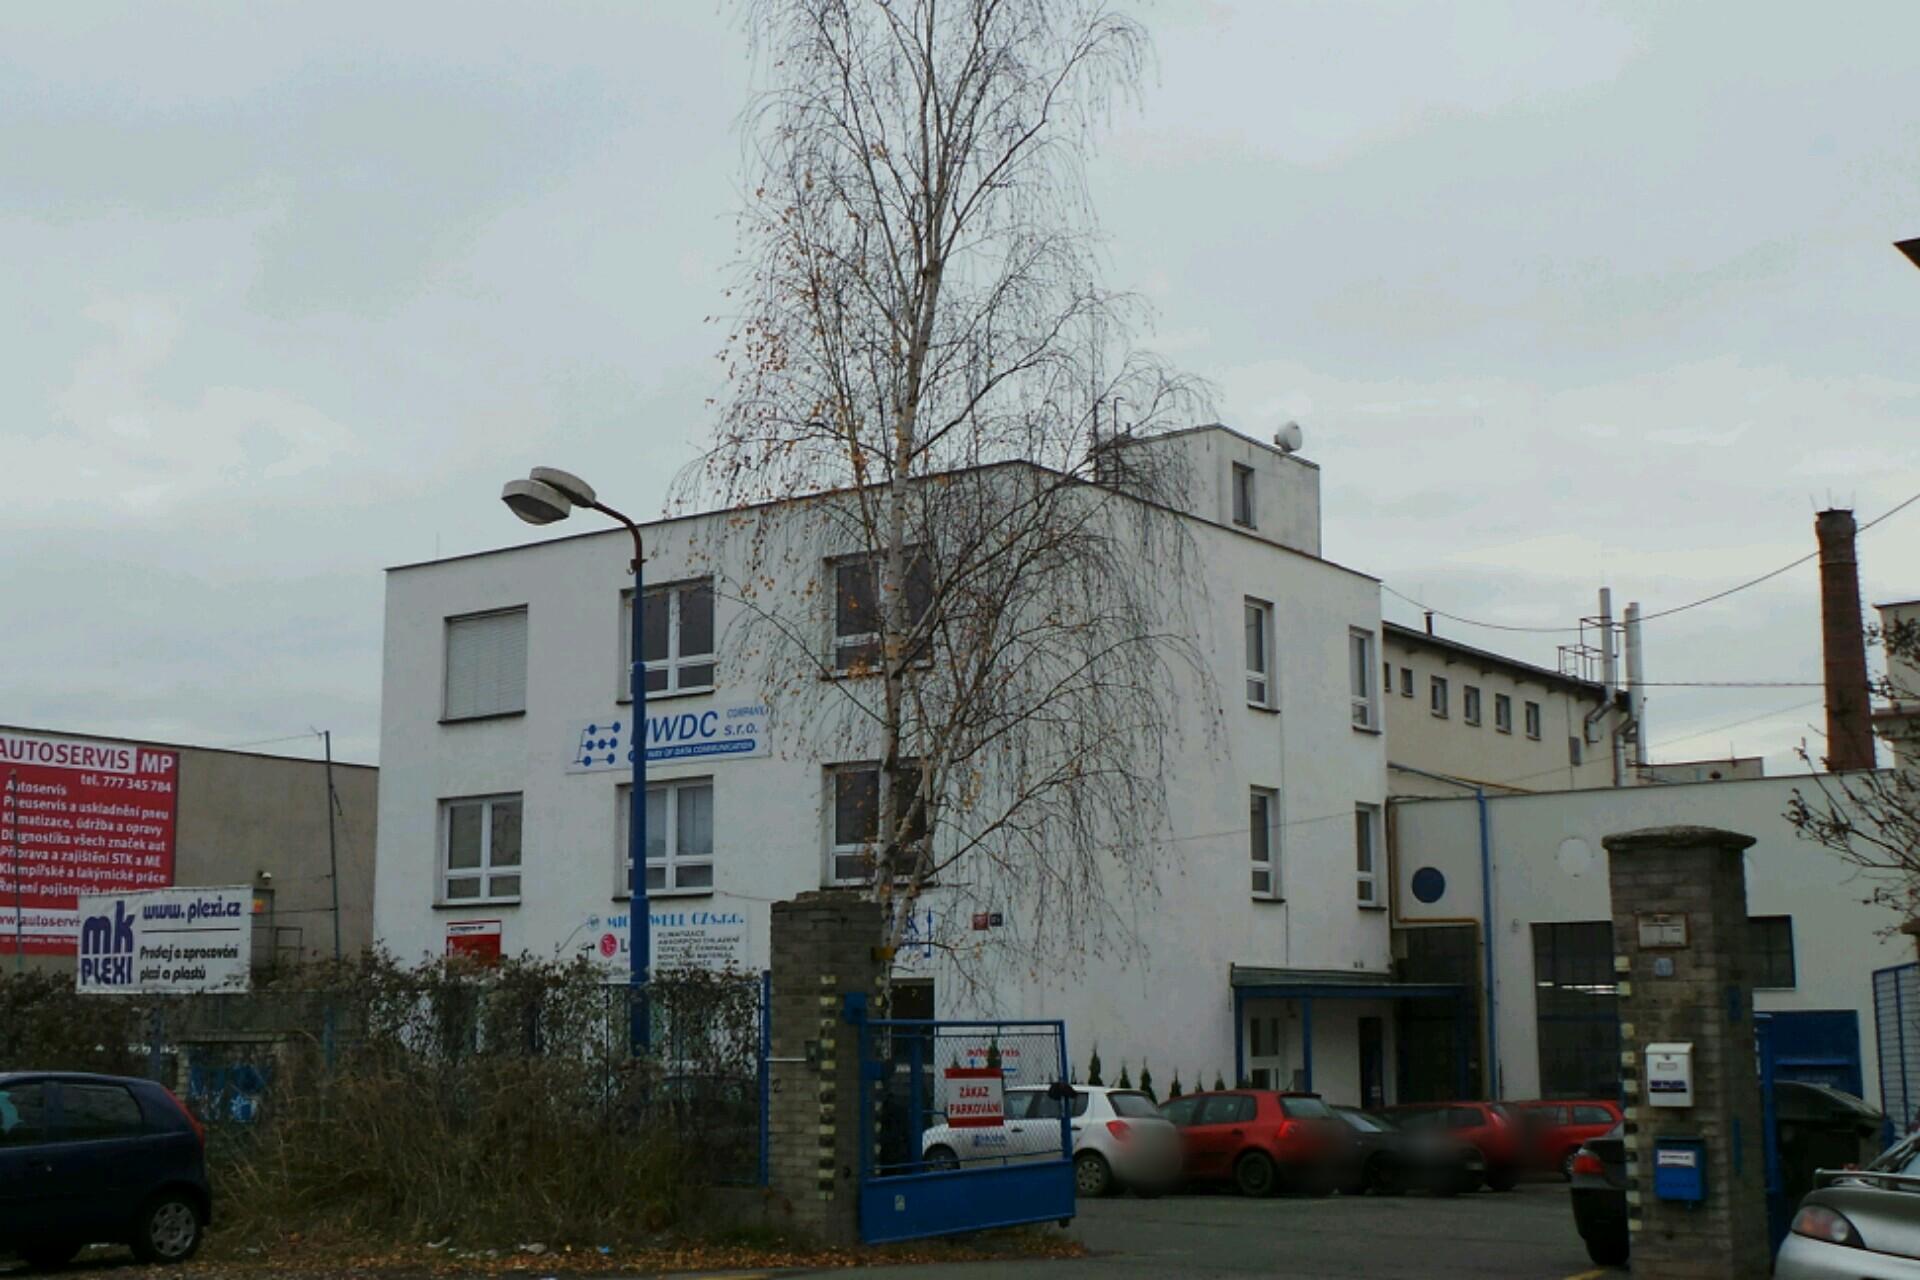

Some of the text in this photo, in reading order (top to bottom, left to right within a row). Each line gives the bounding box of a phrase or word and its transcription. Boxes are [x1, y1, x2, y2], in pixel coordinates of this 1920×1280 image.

[723, 722, 759, 737] s.r.o.
[0, 738, 173, 774] AUTOSERVIS MP
[80, 773, 171, 793] tel. 777 345 784
[69, 803, 76, 812] a
[79, 802, 140, 817] uskladnění
[142, 807, 169, 821] pneu
[77, 817, 113, 832] údržba
[117, 824, 124, 833] a
[126, 823, 162, 837] opravy
[74, 833, 106, 847] všech
[109, 836, 145, 850] značek
[148, 841, 166, 852] aut
[51, 852, 58, 861] a
[112, 853, 133, 865] STK
[67, 869, 76, 878] a
[136, 871, 166, 884] práce
[81, 900, 135, 955] mk
[140, 944, 173, 963] Prodej
[183, 943, 239, 963] zpracování
[81, 956, 133, 986] PLEXI
[162, 969, 170, 980] a
